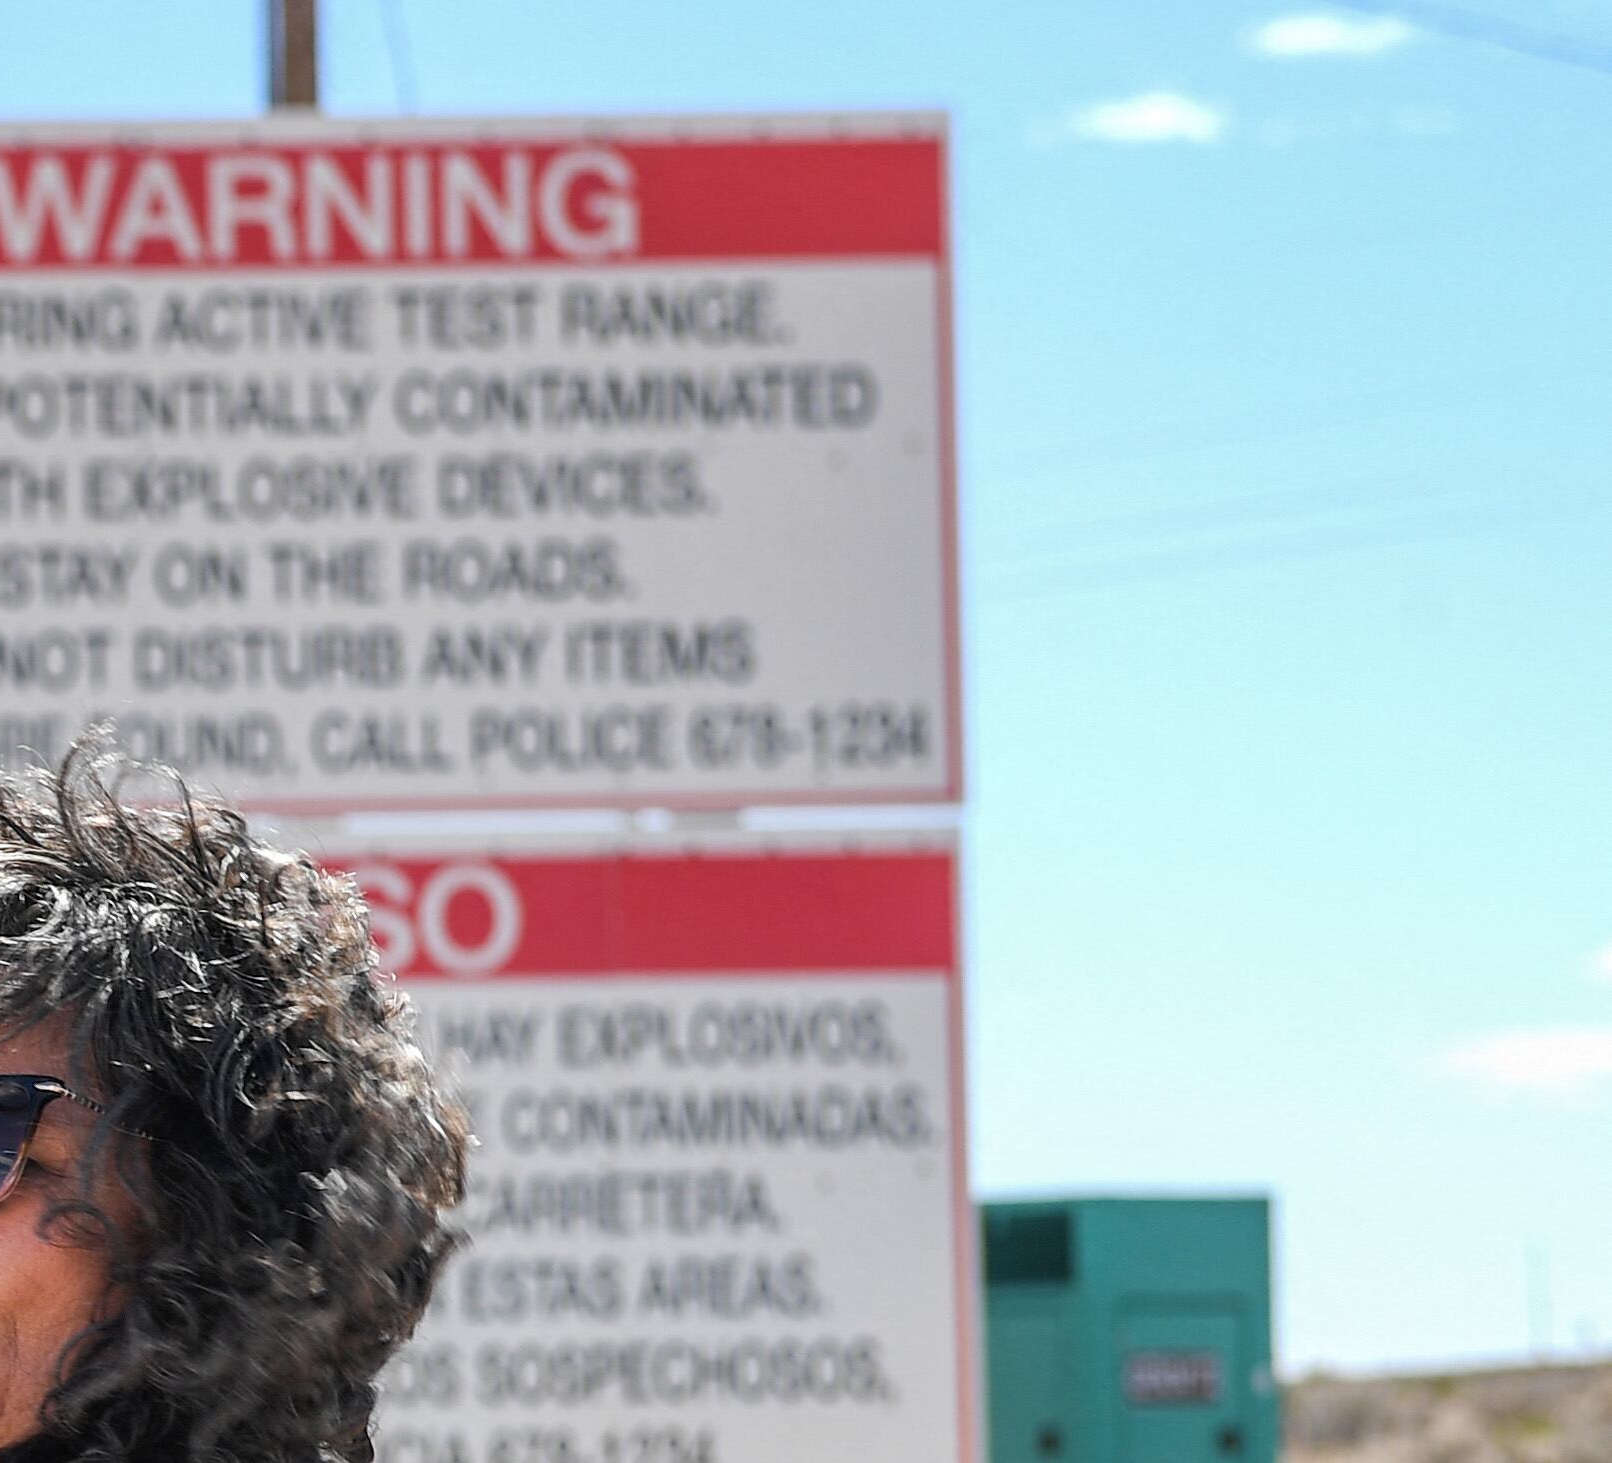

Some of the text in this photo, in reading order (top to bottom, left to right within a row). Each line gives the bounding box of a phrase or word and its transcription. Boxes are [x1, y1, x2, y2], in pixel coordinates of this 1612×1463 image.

[153, 284, 371, 354] ACTIVE
[389, 281, 541, 351] TEST
[559, 278, 795, 349] RANGE.
[392, 360, 881, 435] CONTAMINATED
[79, 453, 416, 524] EXPLOSIVE
[435, 449, 719, 520] DEVICES.
[151, 541, 248, 608] ON
[265, 538, 381, 606] THE
[401, 534, 635, 604] ROADS.
[131, 622, 406, 693] DISTURB
[420, 622, 548, 686] ANY
[564, 615, 757, 686] ITEMS
[77, 707, 297, 776] OUND,
[309, 707, 455, 775] CALL
[467, 702, 673, 774] POLICE
[687, 699, 933, 773] 678-1234
[437, 1008, 543, 1068] HAY
[501, 1081, 937, 1154] CONTAMINADAS.
[462, 1257, 625, 1324] ESTAS
